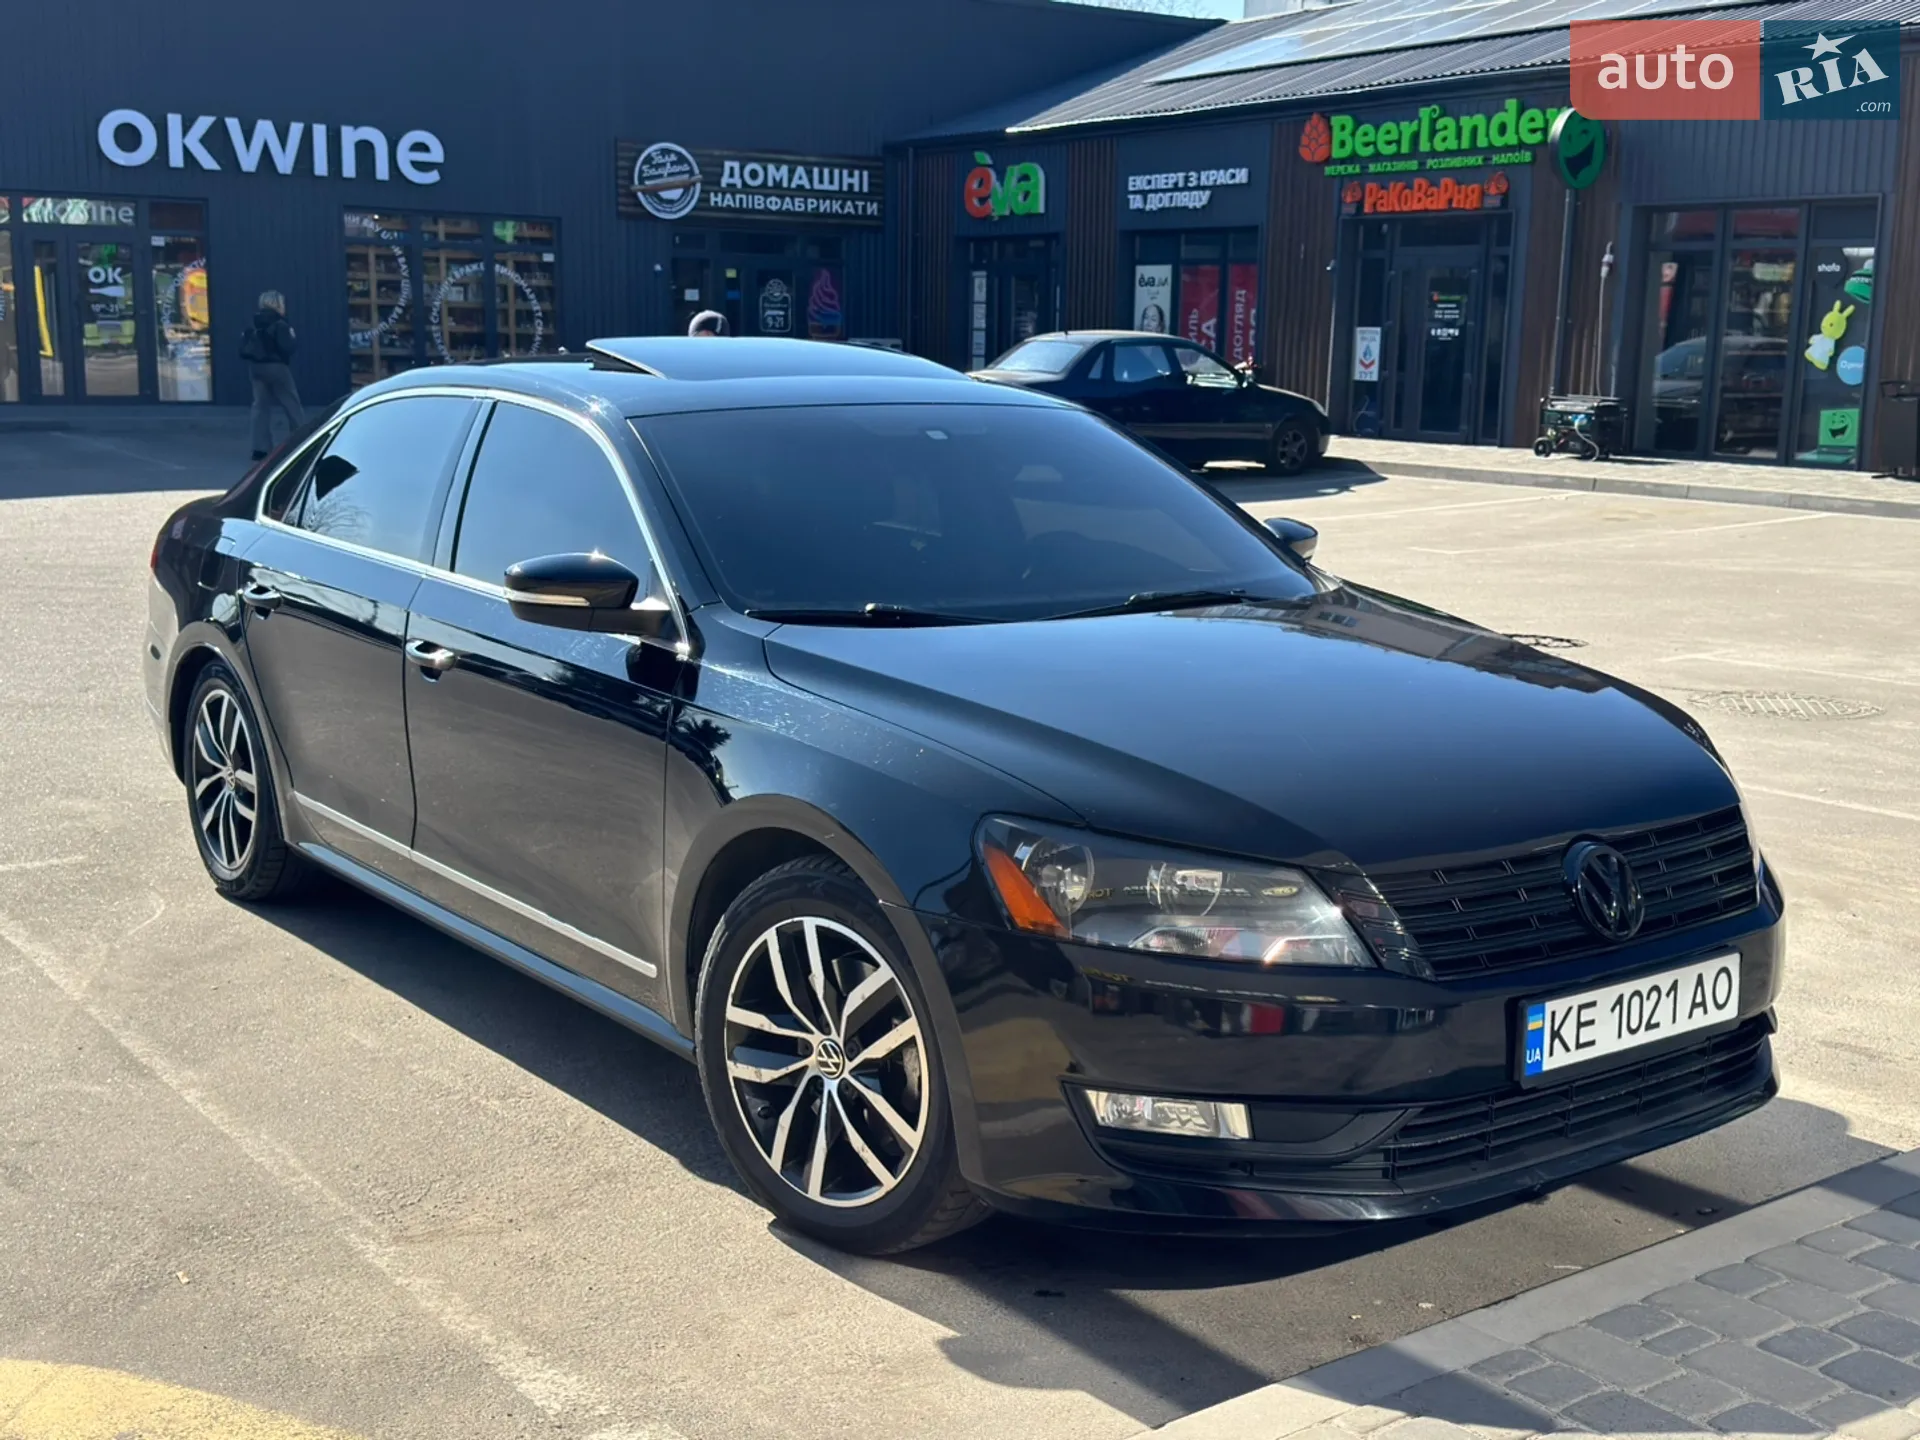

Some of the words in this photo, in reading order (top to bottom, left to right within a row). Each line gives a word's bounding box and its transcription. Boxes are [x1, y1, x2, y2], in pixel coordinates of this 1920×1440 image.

[1324, 163, 1360, 176] МЕРЕЖА
[1368, 159, 1419, 173] МАГАЗИНІВ
[1426, 155, 1484, 169] РОЗЛИВНИХ
[1491, 150, 1533, 165] НАПОЇВ
[720, 160, 869, 193] ДОМАШНІ
[1127, 172, 1186, 191] ЕКСПЕРТ
[1187, 171, 1199, 187] З
[1200, 167, 1250, 186] КРАСИ
[709, 192, 879, 217] НАПІВФАБРИКАТИ
[1127, 194, 1144, 210] ТА
[1145, 190, 1212, 211] ДОГЛЯДУ
[88, 266, 124, 284] OK
[1232, 288, 1247, 361] ДОГЛЯД
[1548, 1000, 1598, 1058] KE
[1610, 978, 1679, 1039] 1021
[1688, 966, 1732, 1020] AO
[1526, 1047, 1541, 1064] UA
